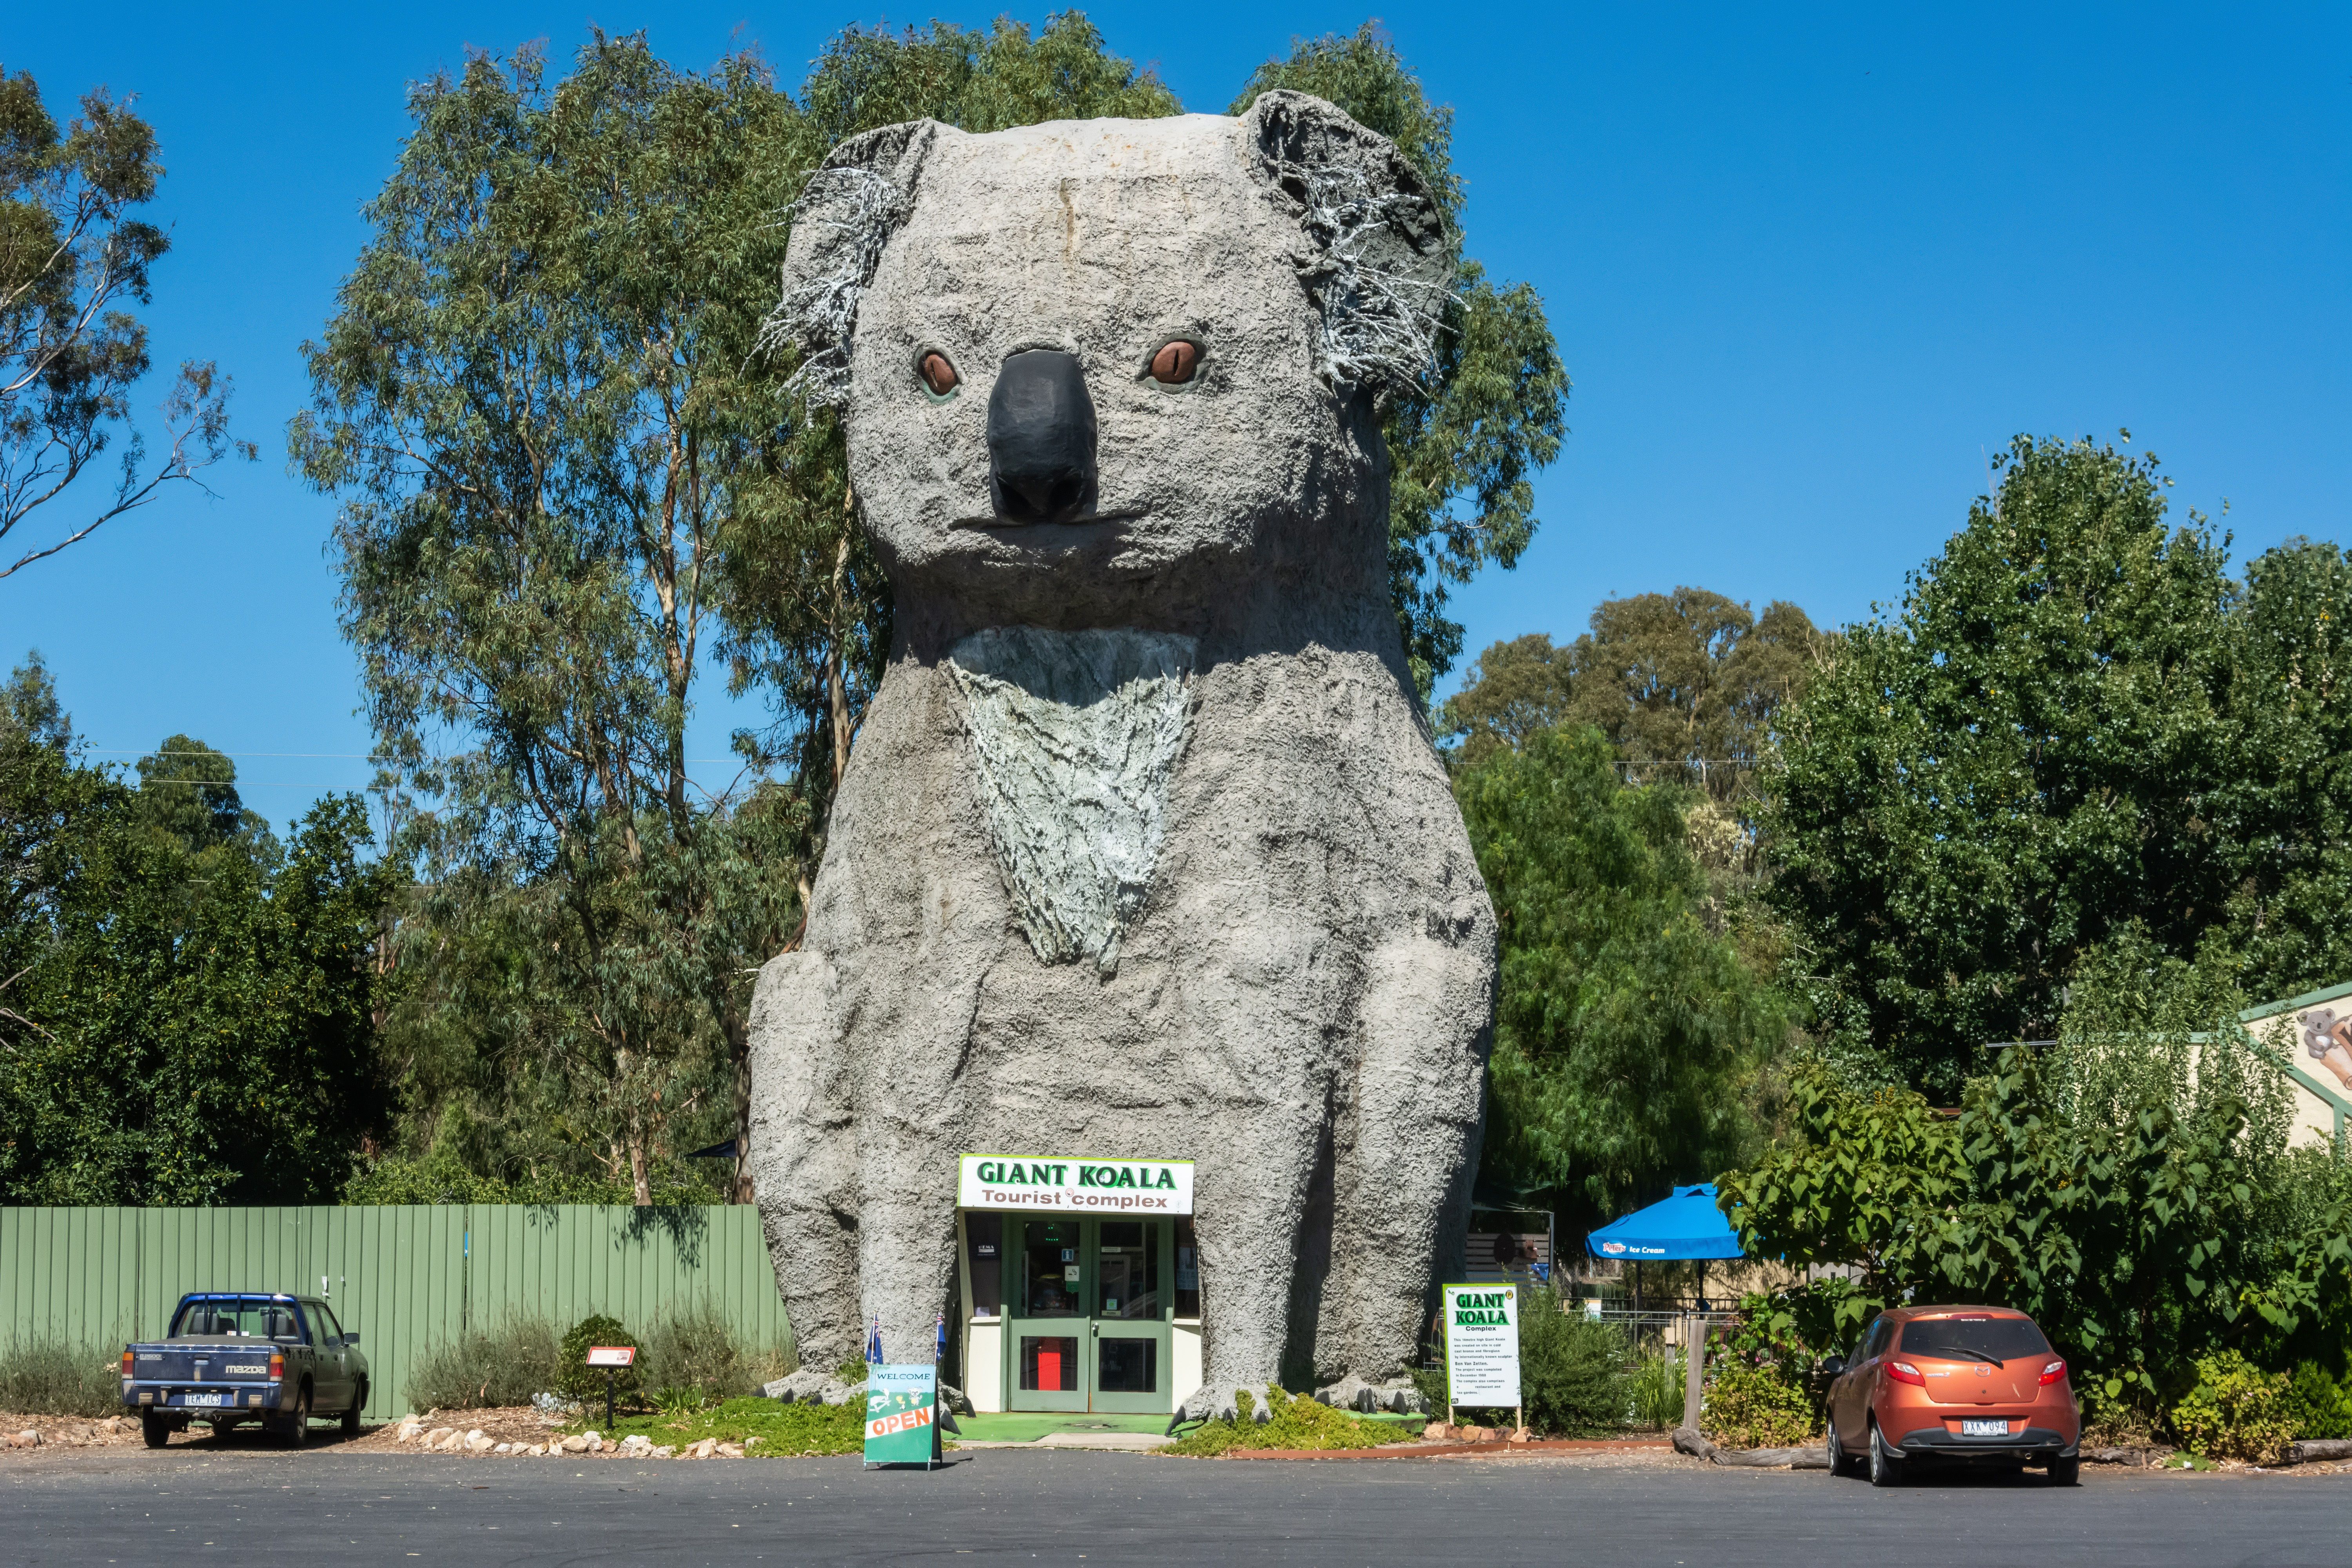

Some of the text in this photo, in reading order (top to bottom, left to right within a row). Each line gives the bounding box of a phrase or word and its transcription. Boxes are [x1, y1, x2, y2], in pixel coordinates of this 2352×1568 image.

[977, 1162, 1178, 1190] GIANT KOALA
[982, 1190, 1167, 1209] Tourist complex
[1603, 1243, 1626, 1252] Peters
[1456, 1294, 1505, 1308] GIANT
[1454, 1310, 1510, 1325] KOALA
[873, 1407, 930, 1436] OPEN
[1964, 1421, 2006, 1431] XXK 094
